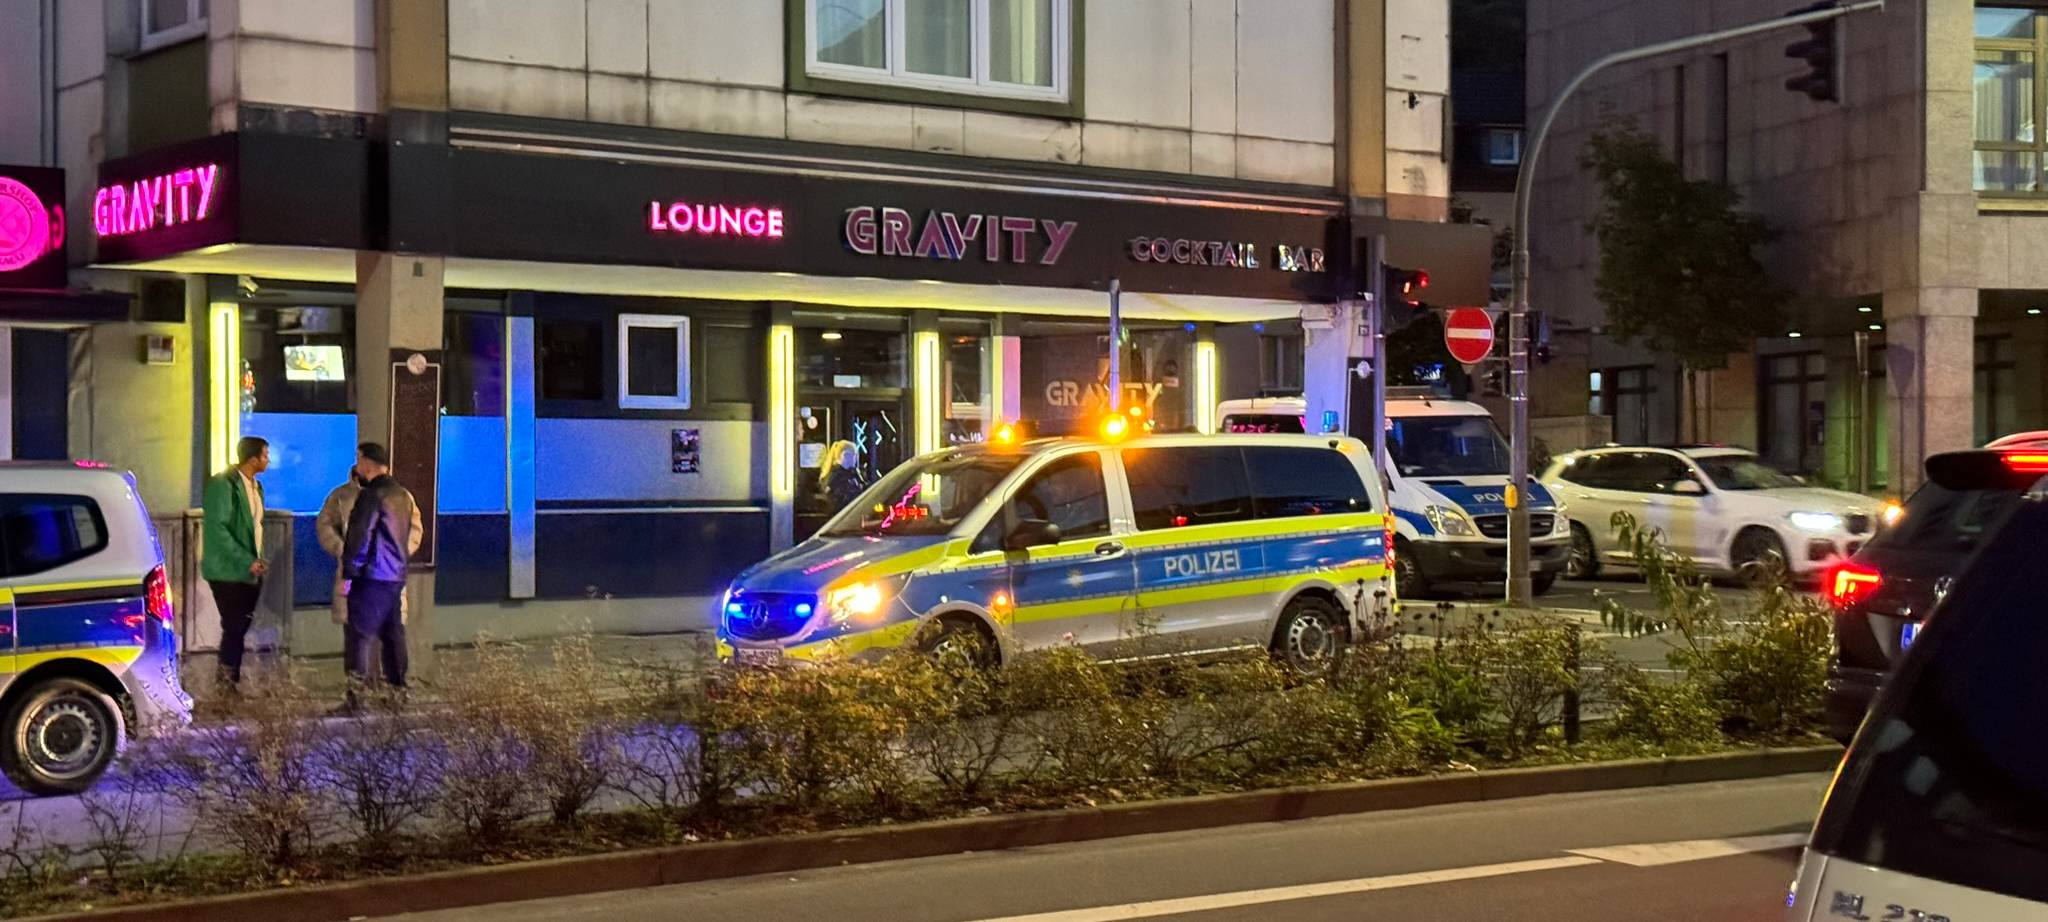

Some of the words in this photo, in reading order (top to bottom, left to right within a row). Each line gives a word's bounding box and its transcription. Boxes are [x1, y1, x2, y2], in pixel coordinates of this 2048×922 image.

[95, 164, 217, 236] GRAVITY
[650, 200, 783, 237] LOUNGE
[845, 206, 1078, 264] GRAVITY
[1130, 236, 1259, 269] COCKTAIL
[1278, 244, 1326, 272] BAR
[1164, 549, 1241, 577] POLIZEI
